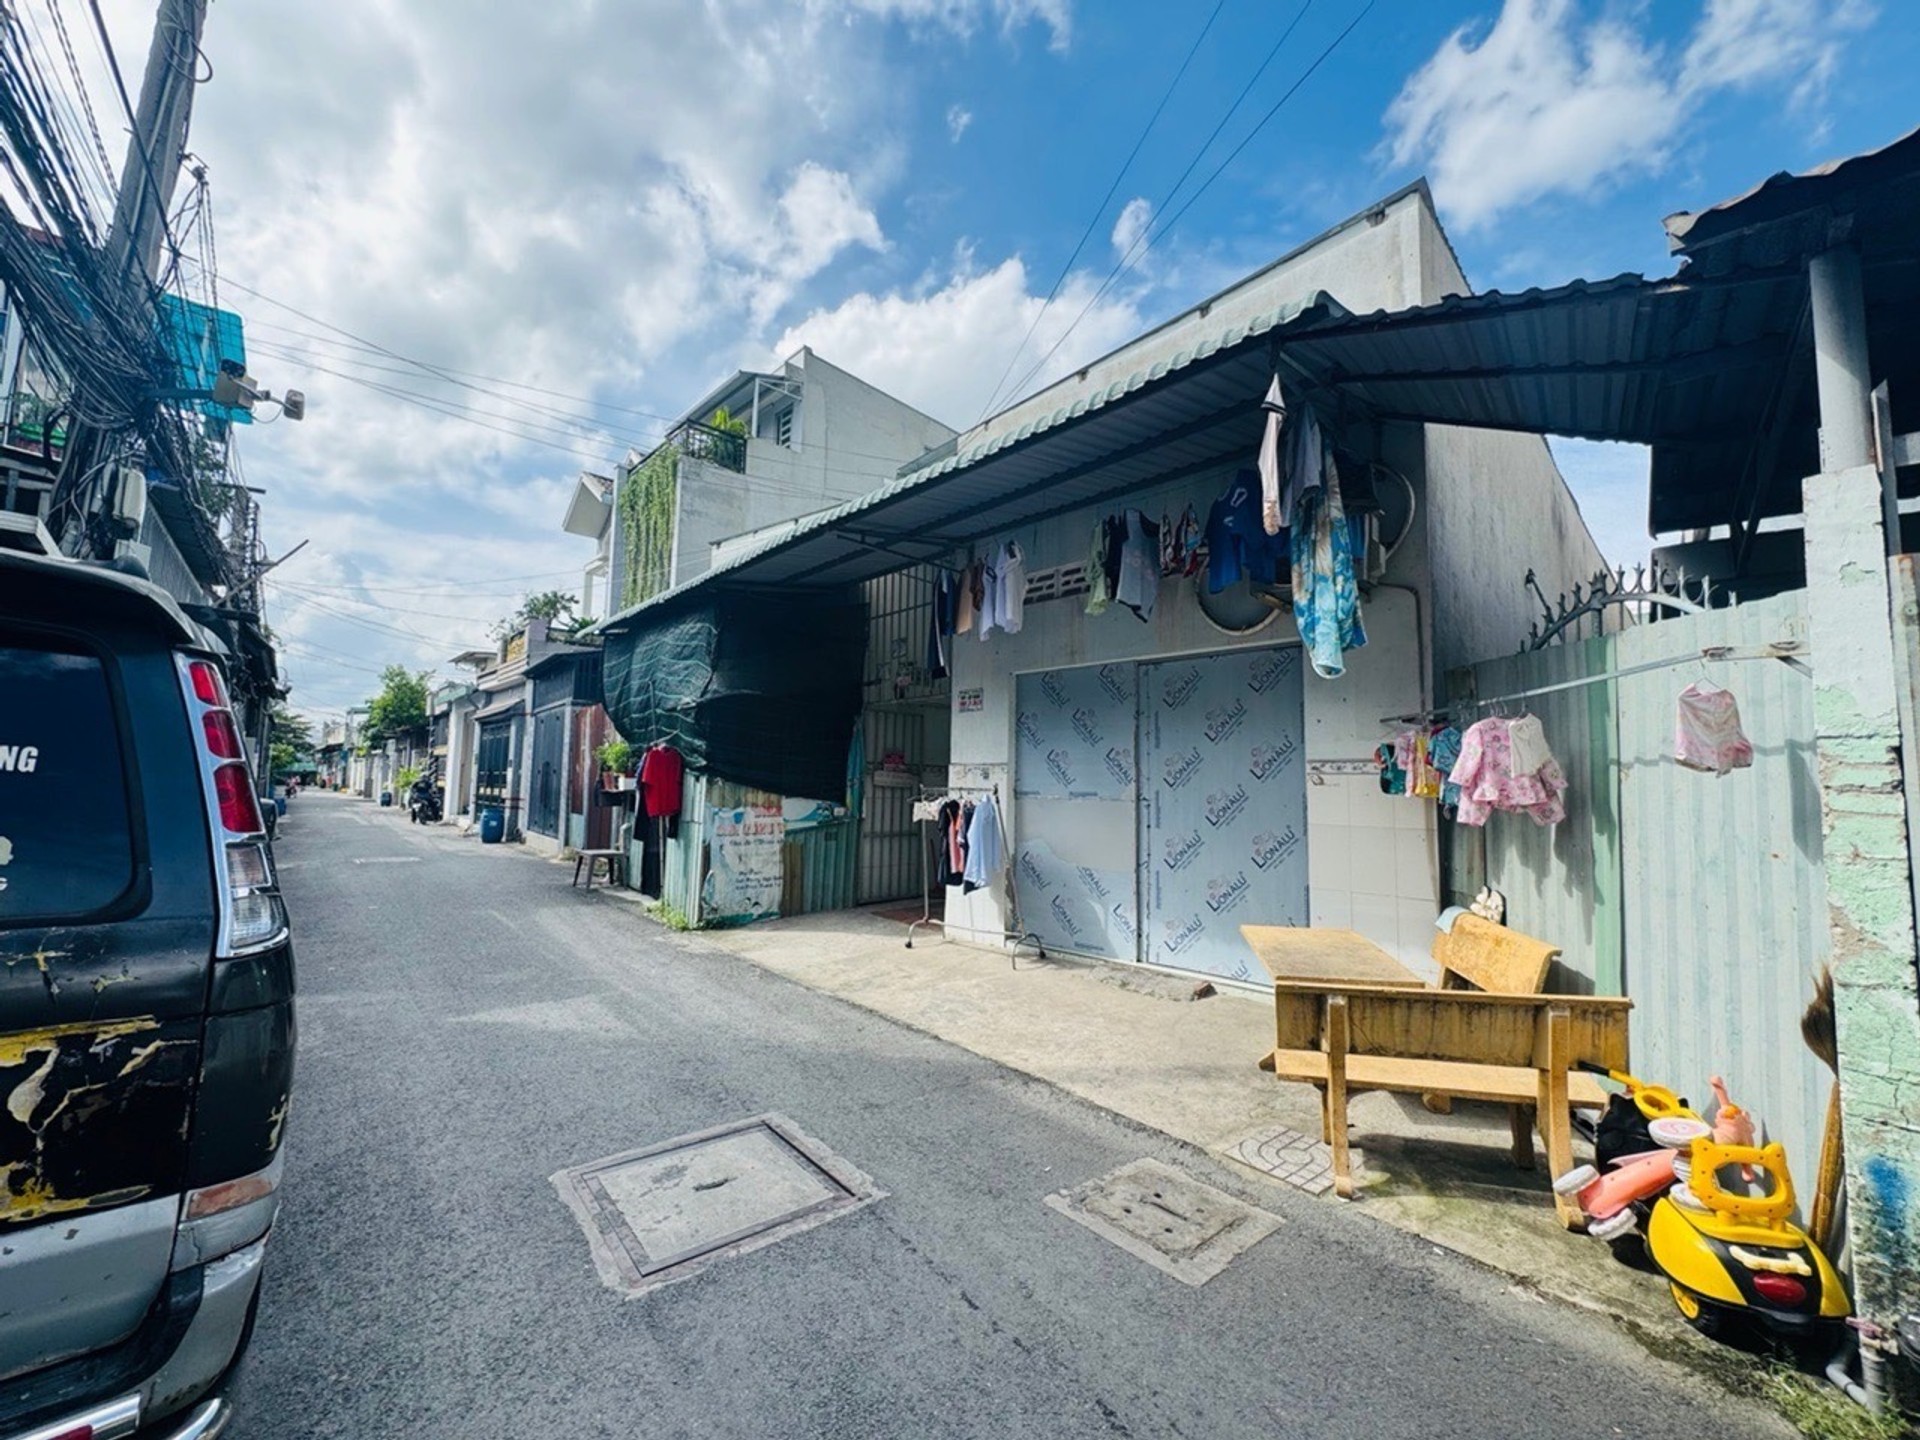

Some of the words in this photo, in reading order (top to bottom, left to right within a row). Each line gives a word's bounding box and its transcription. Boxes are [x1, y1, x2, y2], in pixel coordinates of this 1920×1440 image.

[1204, 699, 1244, 742] LIONALU
[1249, 736, 1293, 780] LIONALU
[1205, 785, 1246, 827] LIONALU
[1250, 826, 1296, 869] LIONALU
[1205, 872, 1248, 912] LIONALU
